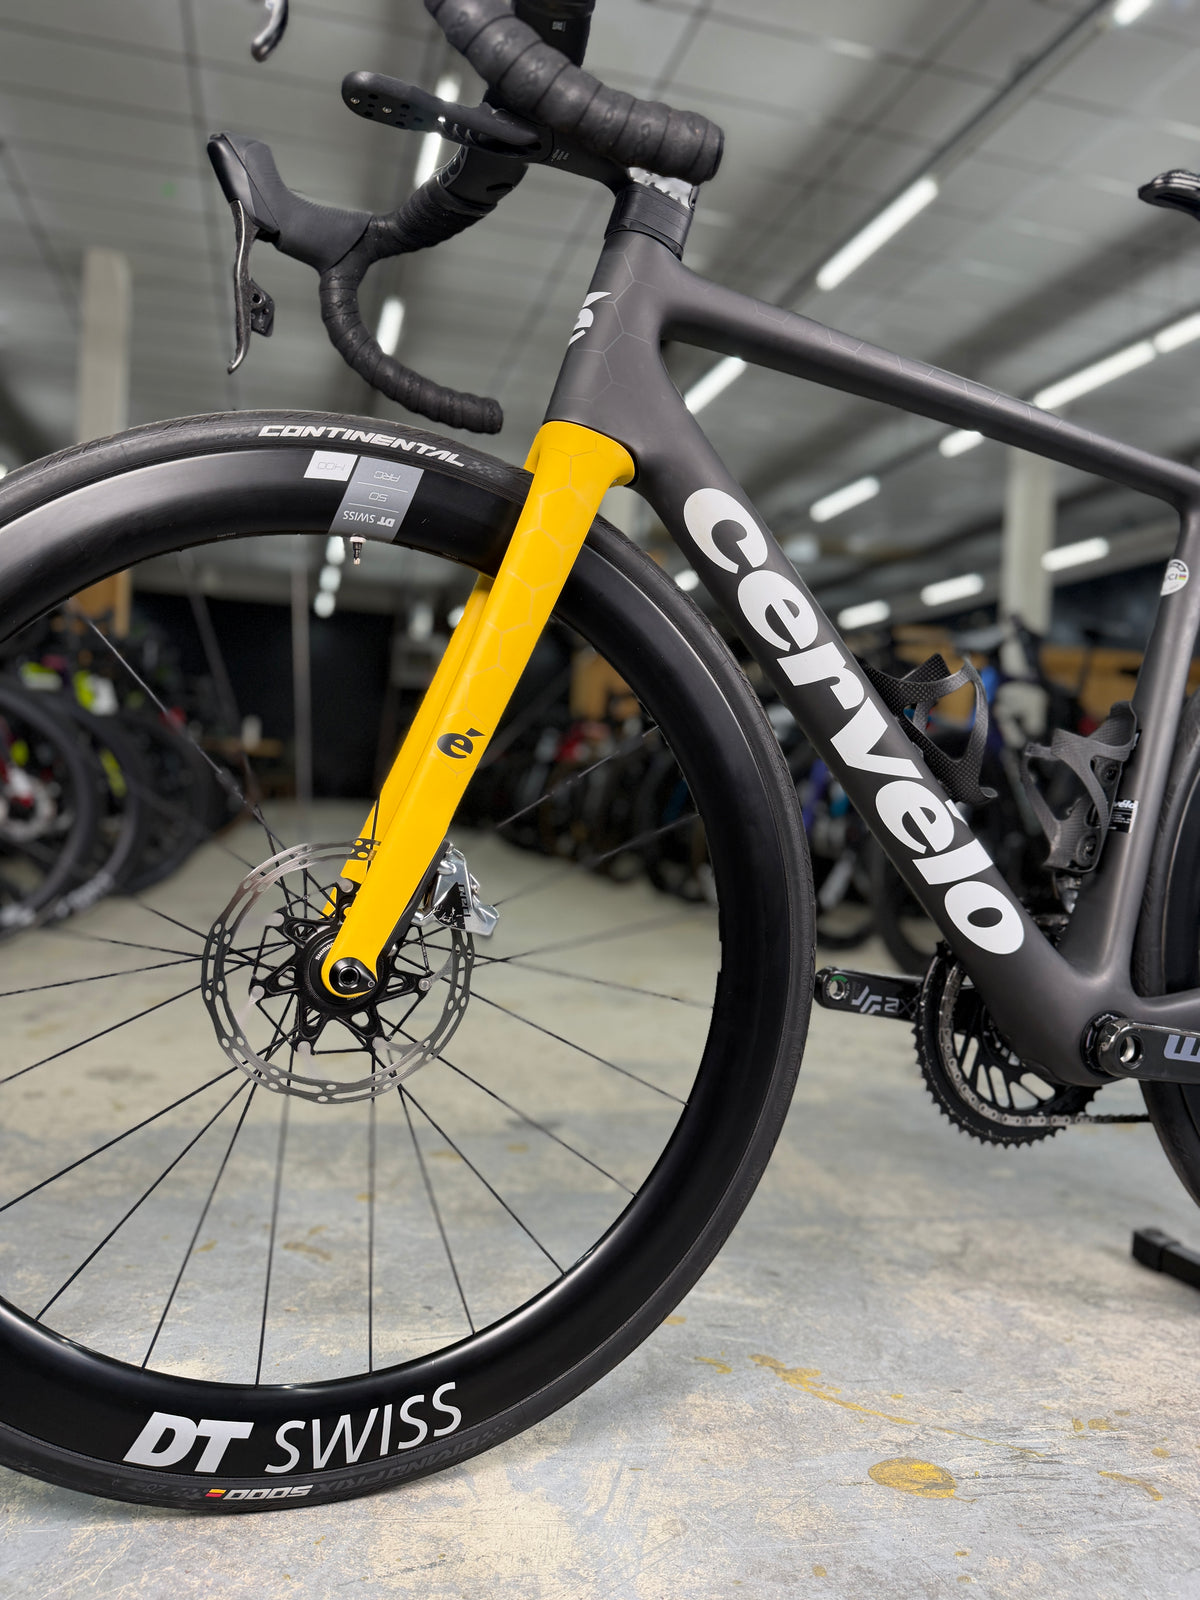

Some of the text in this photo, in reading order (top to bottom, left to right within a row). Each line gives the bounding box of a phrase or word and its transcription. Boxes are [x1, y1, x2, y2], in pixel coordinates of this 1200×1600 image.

[258, 425, 465, 467] CONTINENTAL
[343, 510, 396, 528] DT SWISS
[683, 487, 1025, 955] cervélo
[122, 1381, 462, 1474] DT SWISS
[223, 1484, 313, 1500] 5000
